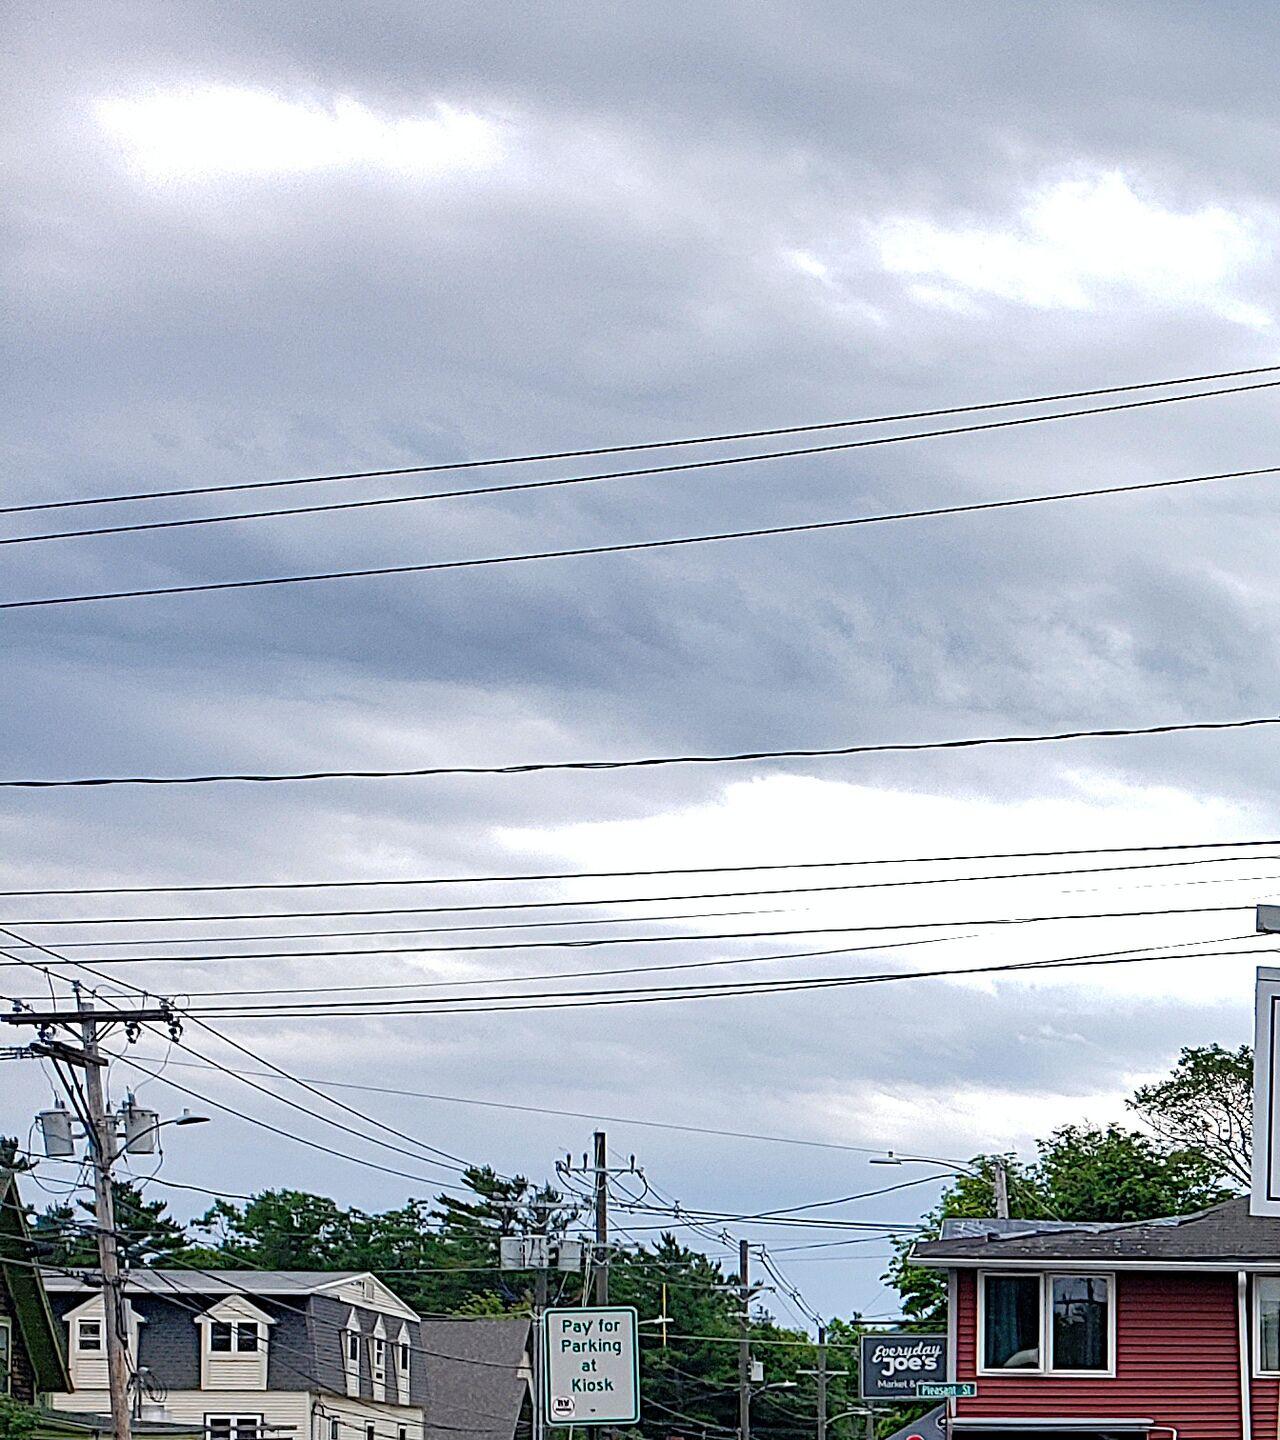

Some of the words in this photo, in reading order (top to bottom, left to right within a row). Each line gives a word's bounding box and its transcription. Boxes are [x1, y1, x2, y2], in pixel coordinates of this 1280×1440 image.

[562, 1319, 593, 1336] Pay
[598, 1318, 621, 1333] for
[561, 1338, 622, 1356] Parking
[872, 1341, 942, 1364] Everyday
[581, 1358, 597, 1372] at
[571, 1377, 614, 1393] Kiosk
[877, 1379, 908, 1389] Market
[908, 1380, 916, 1389] &
[921, 1384, 956, 1396] Pleasant
[961, 1384, 971, 1395] St
